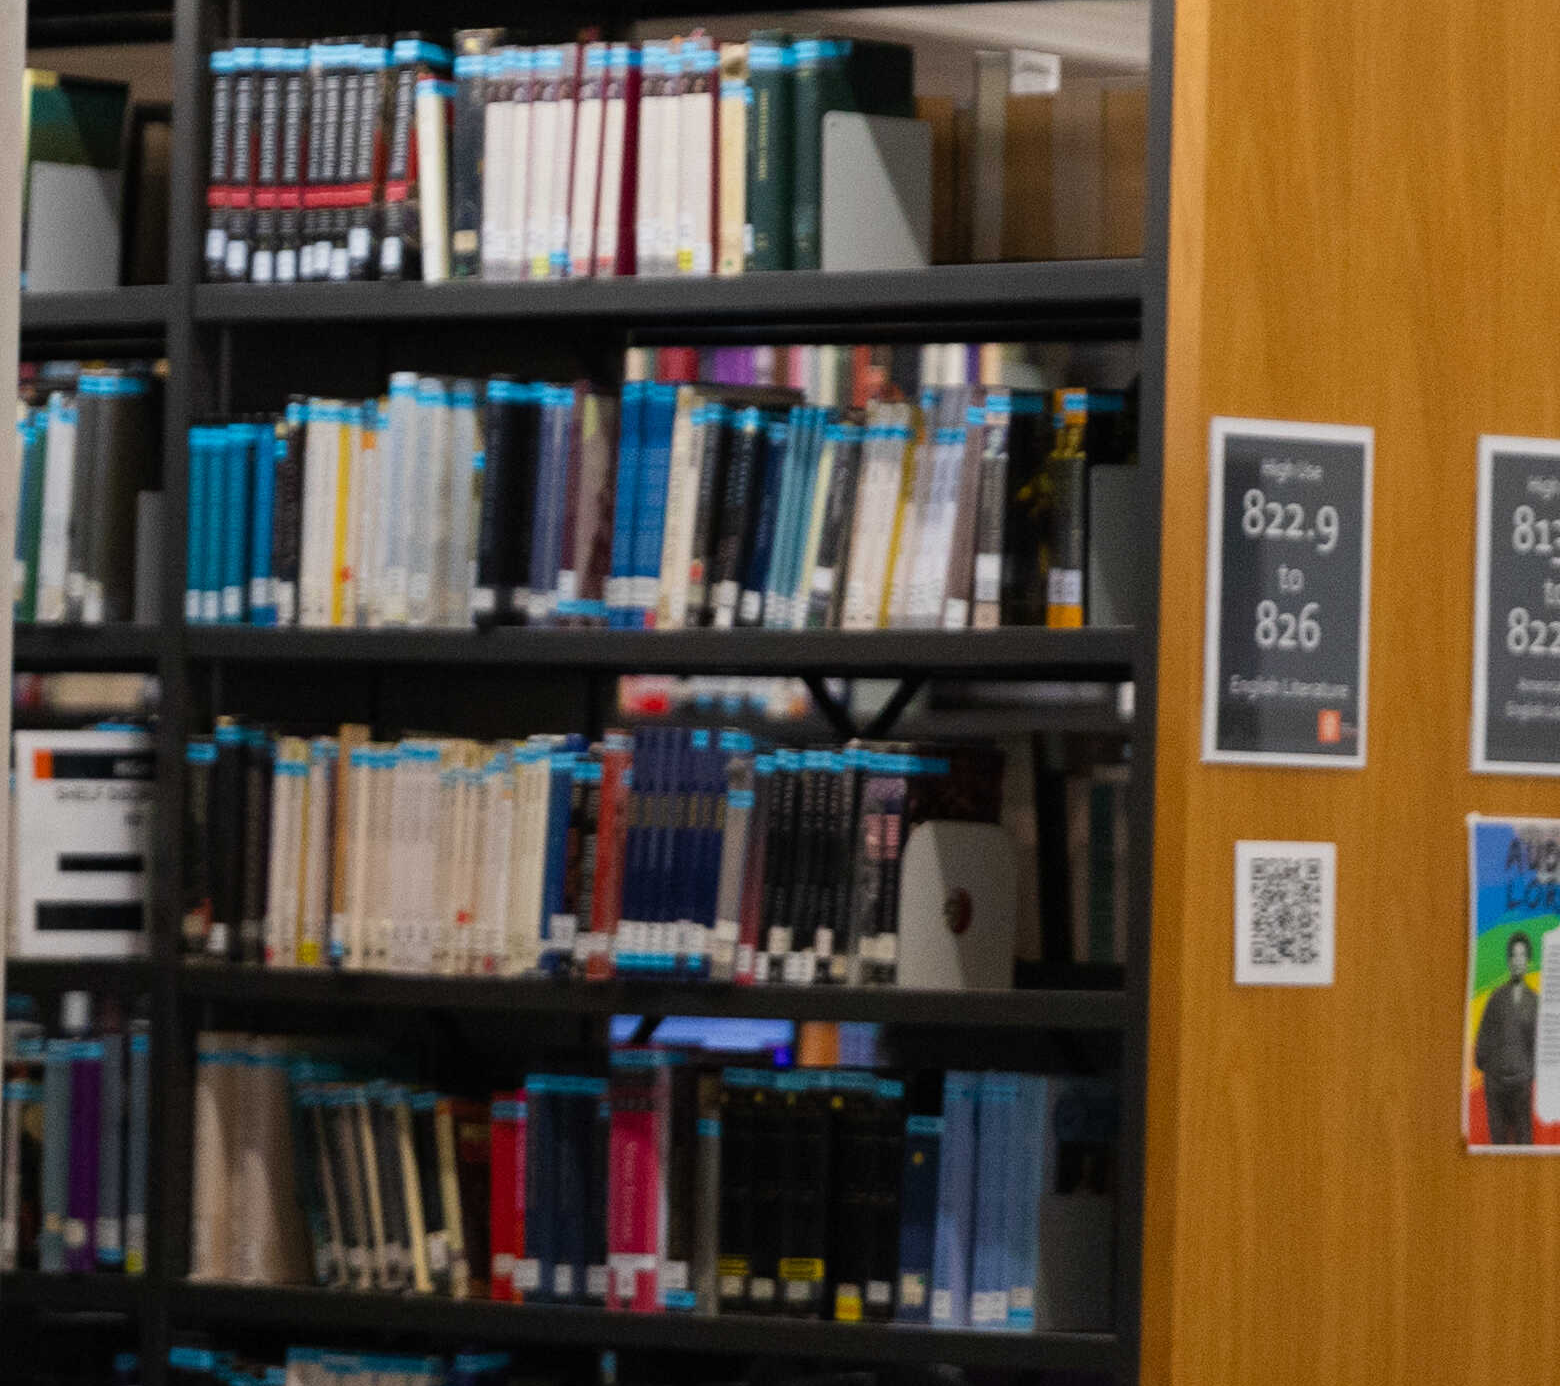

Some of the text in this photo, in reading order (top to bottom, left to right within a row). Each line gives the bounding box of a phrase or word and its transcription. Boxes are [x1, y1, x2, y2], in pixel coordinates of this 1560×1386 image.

[1242, 488, 1340, 553] 822.9
[1278, 563, 1305, 594] to
[1255, 600, 1321, 651] 826
